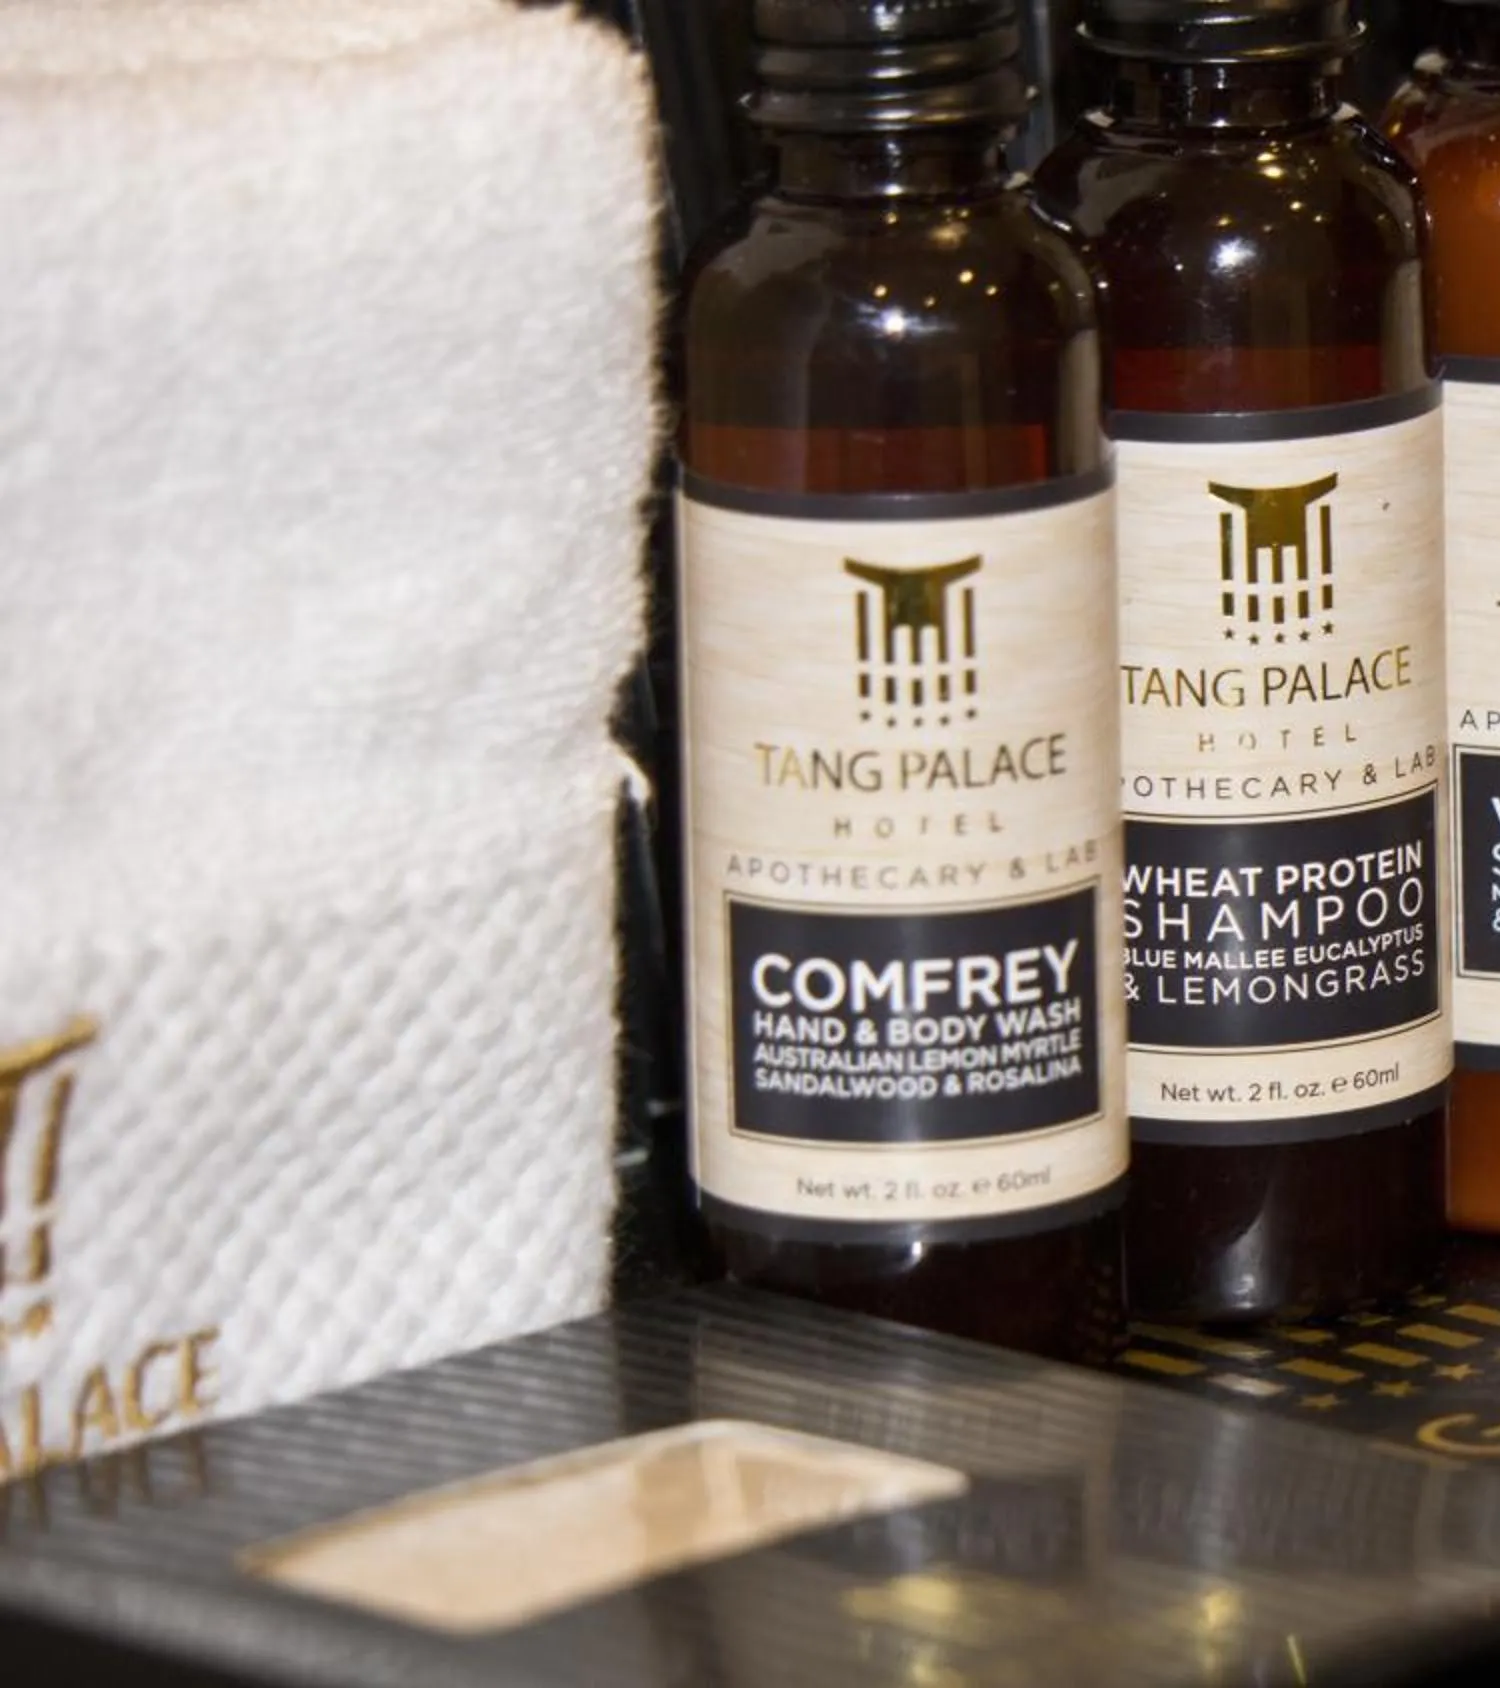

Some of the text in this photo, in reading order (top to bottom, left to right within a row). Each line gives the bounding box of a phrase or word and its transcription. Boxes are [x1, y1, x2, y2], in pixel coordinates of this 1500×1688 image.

[1120, 645, 1412, 709] TANG PALACE
[754, 733, 1068, 792] TANG PALACE
[1198, 722, 1358, 753] HOTEL
[1121, 744, 1436, 800] OTHECARY & LAB
[833, 812, 1006, 840] HOTEL
[726, 838, 1098, 890] APOTHECARY & LAB
[1121, 840, 1422, 898] WHEAT PROTEIN
[1121, 876, 1424, 942] SHAMPOO
[1184, 948, 1286, 970] MALLEE
[1293, 923, 1425, 966] EUCALYPTUS
[751, 939, 1080, 1014] COMFREY
[1122, 949, 1425, 1006] & LEMONGRASS
[753, 997, 1081, 1047] HAND & BODY WASH
[753, 1027, 1082, 1074] AUSTRALIAN LEMON MYRTLE
[753, 1055, 1083, 1099] SANDALWOOD & ROSALINA
[1161, 1083, 1200, 1102] Net
[1207, 1085, 1241, 1103] wt.
[1249, 1083, 1262, 1102] 2
[1269, 1081, 1287, 1100] fl.
[1294, 1082, 1325, 1098] oz.
[1353, 1062, 1399, 1090] 60ml
[797, 1177, 835, 1199] Net
[843, 1181, 877, 1200] wt.
[883, 1180, 899, 1201] 2
[996, 1165, 1052, 1193] 60ml
[0, 1324, 221, 1478] LACE
